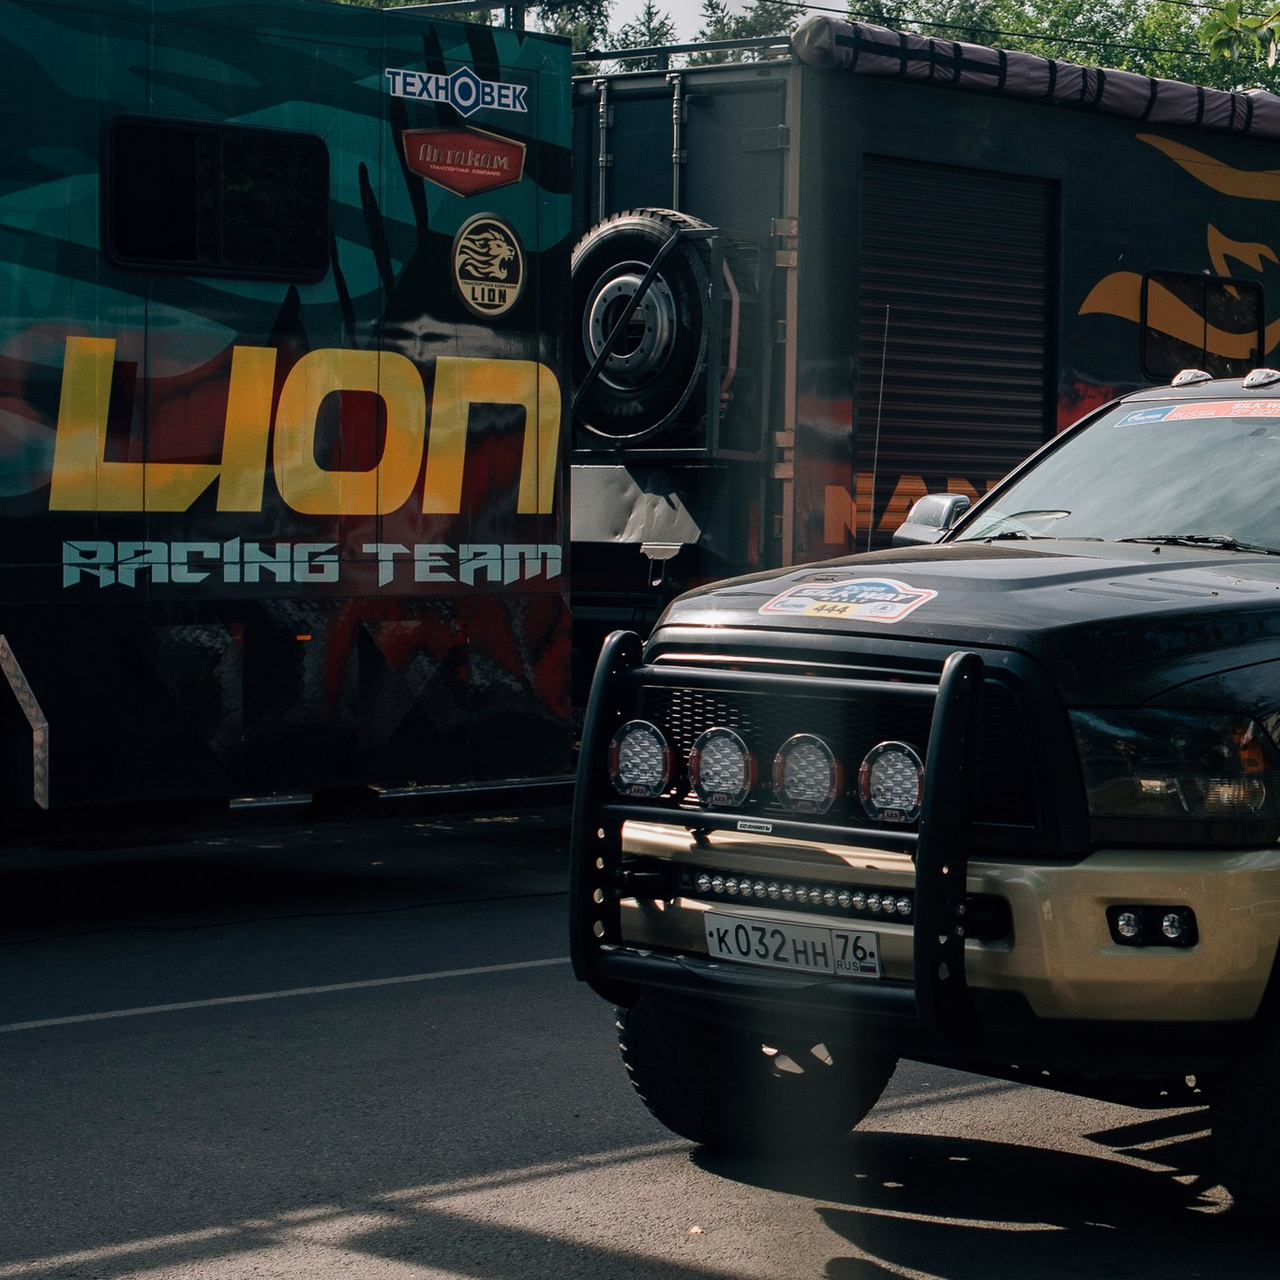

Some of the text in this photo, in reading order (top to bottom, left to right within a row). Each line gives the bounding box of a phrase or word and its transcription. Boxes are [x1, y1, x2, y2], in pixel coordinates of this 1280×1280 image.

[387, 70, 527, 111] ТЕХНОВЕК
[471, 287, 507, 303] LION
[1171, 409, 1217, 419] RUSSIA
[49, 336, 563, 515] LION
[62, 536, 563, 589] RACING TEAM
[795, 589, 915, 602] SILK WAY
[813, 603, 851, 614] 444
[835, 933, 867, 961] 76
[837, 960, 860, 971] RUS
